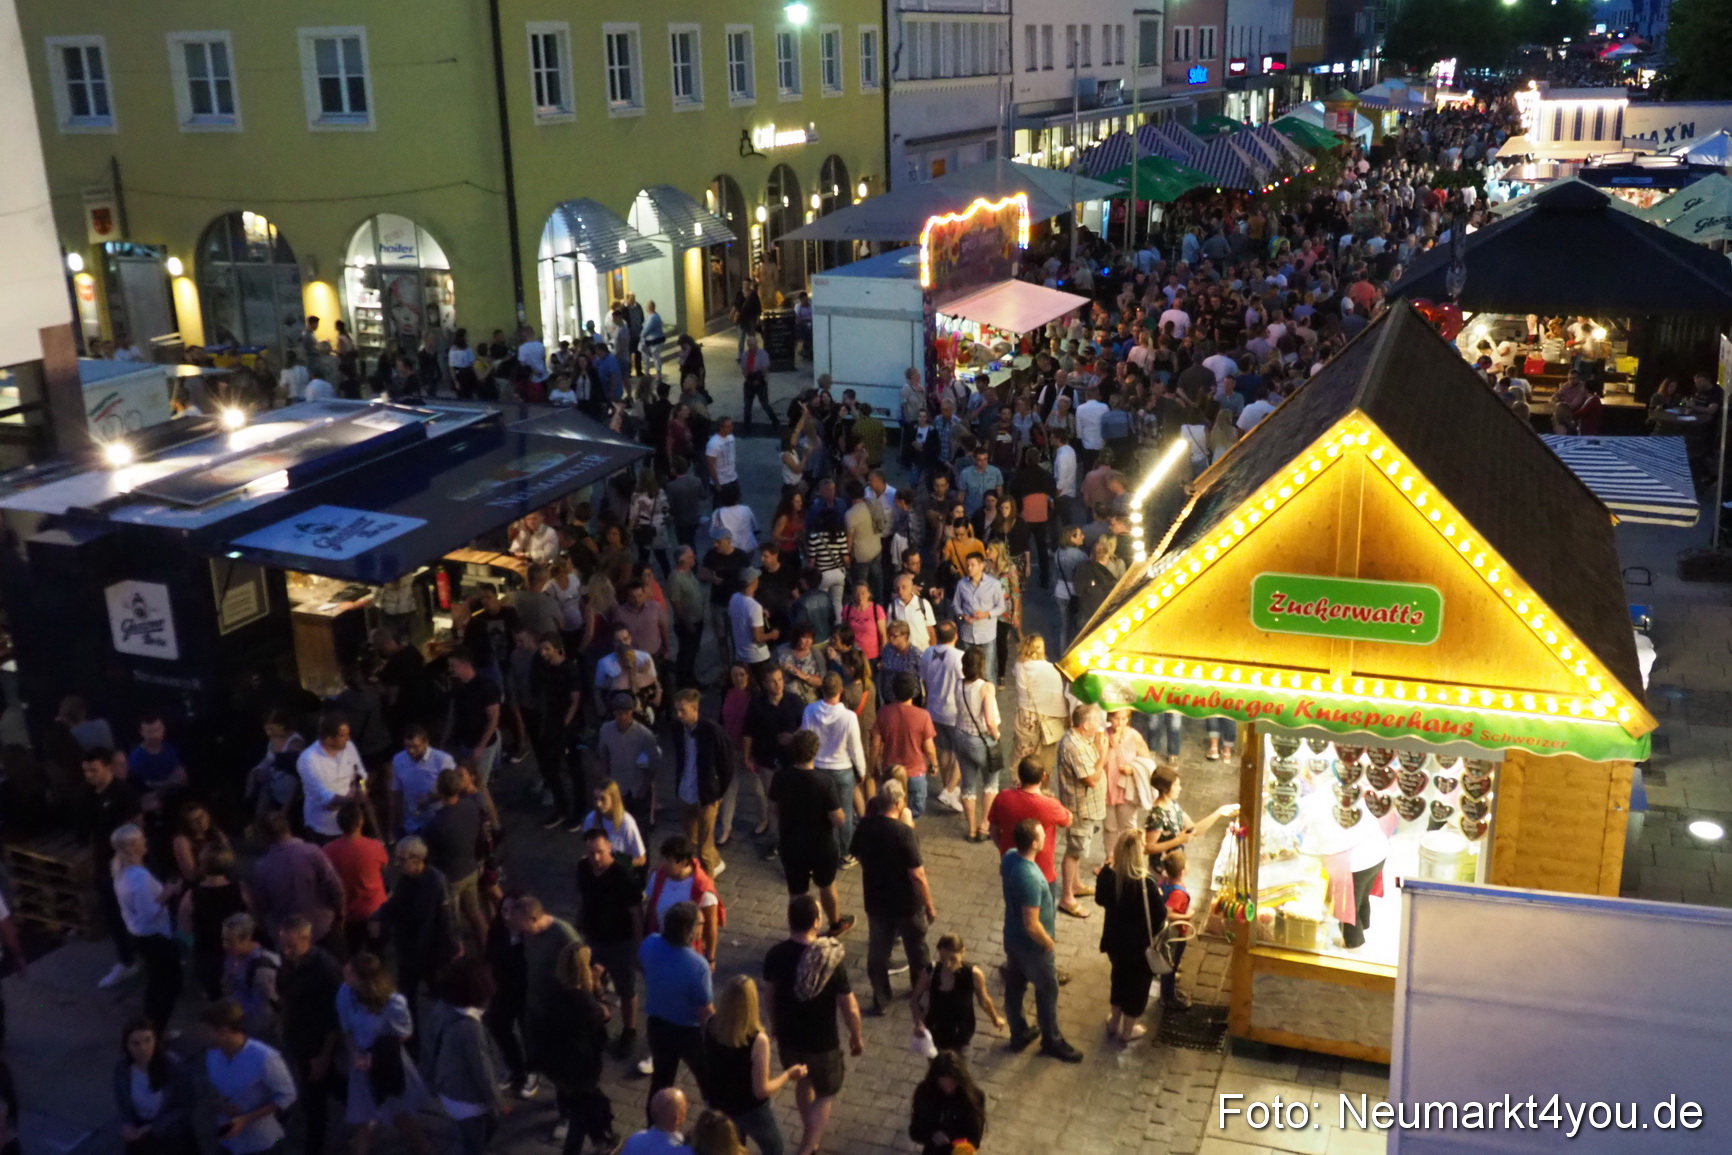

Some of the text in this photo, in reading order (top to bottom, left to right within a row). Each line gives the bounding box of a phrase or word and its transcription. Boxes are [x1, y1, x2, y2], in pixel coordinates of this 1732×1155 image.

[1268, 592, 1424, 626] Zuckerwatte
[1142, 684, 1568, 750] Nürnberger Knusperhaus Schweizer
